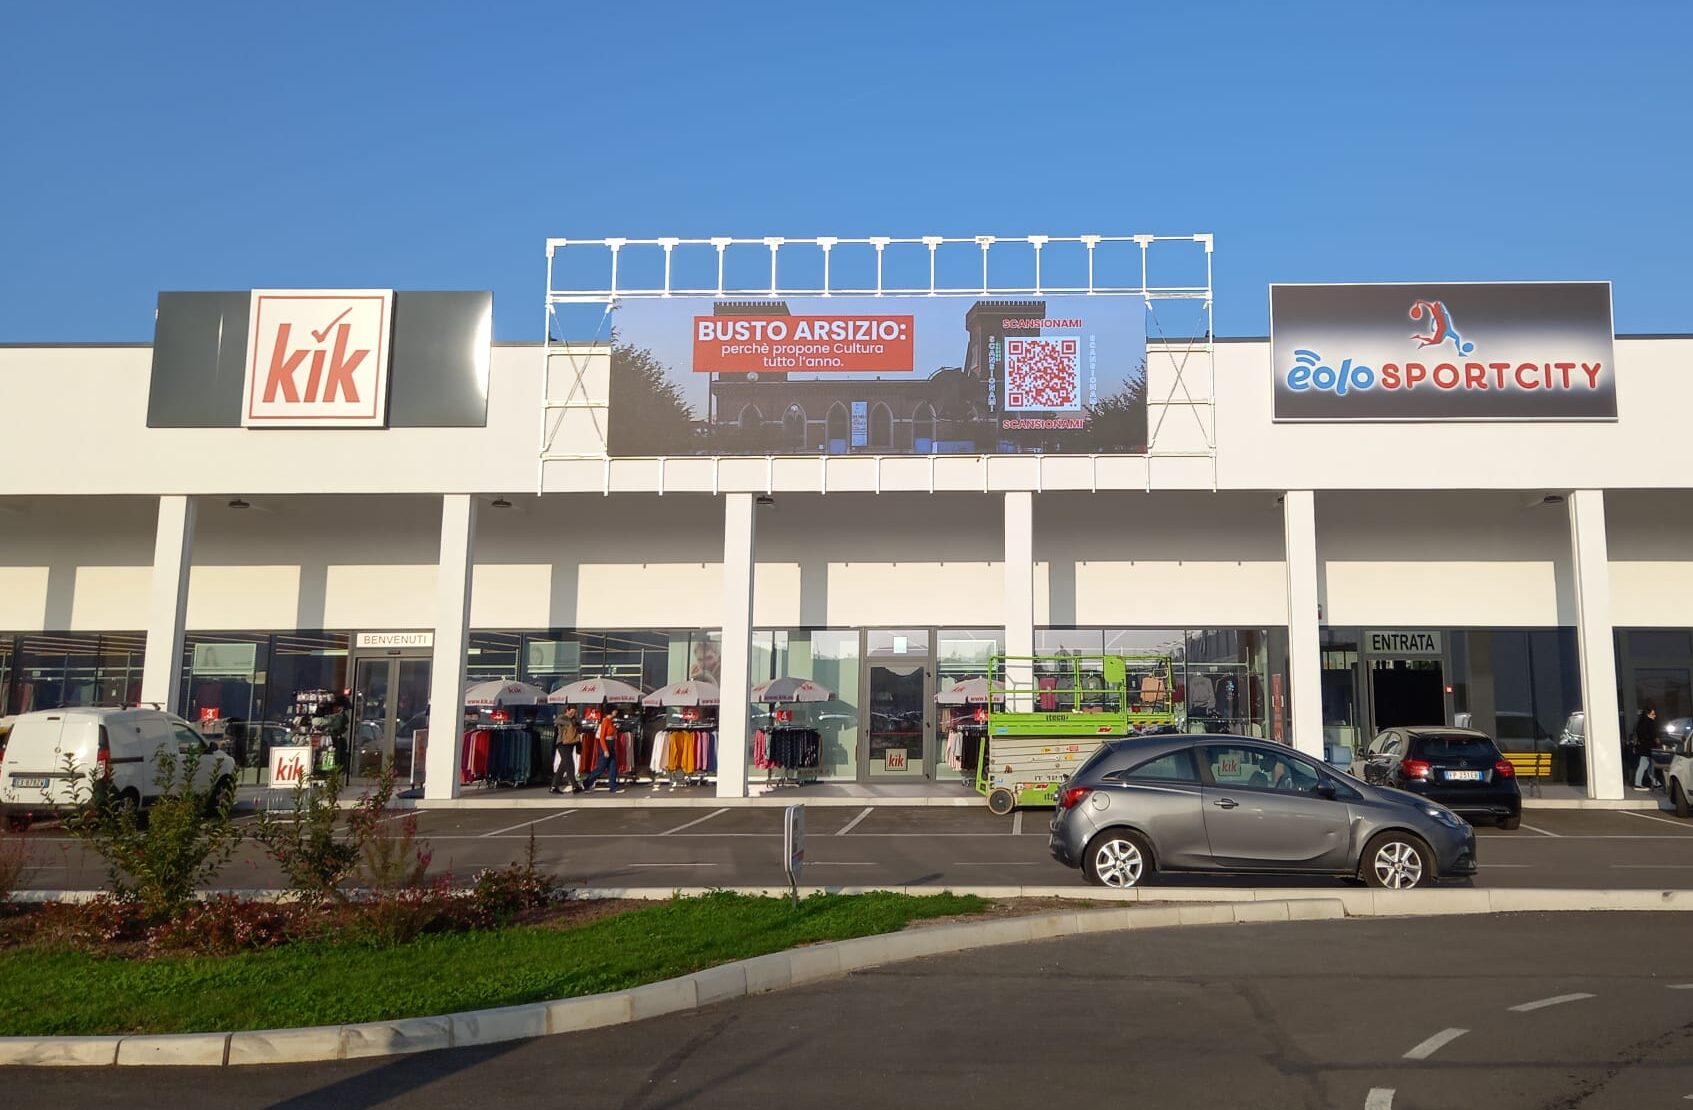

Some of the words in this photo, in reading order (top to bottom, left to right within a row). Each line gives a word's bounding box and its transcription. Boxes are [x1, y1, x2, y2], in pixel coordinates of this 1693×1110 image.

[697, 320, 788, 341] BUSTO
[793, 319, 907, 341] ARSIZIO:
[1002, 319, 1083, 329] SCANSIONAMI
[262, 307, 371, 403] kik
[721, 343, 769, 357] perchè
[773, 344, 830, 357] propone
[833, 342, 884, 354] Cultura
[763, 356, 796, 367] tutto
[799, 355, 844, 367] l'anno.
[1381, 362, 1601, 390] SPORTCITY
[1002, 419, 1084, 429] SCANSIONAMI
[363, 635, 427, 644] BENVENUTI
[1372, 634, 1435, 651] ENTRATA
[888, 753, 904, 767] kik
[1222, 760, 1237, 772] kik
